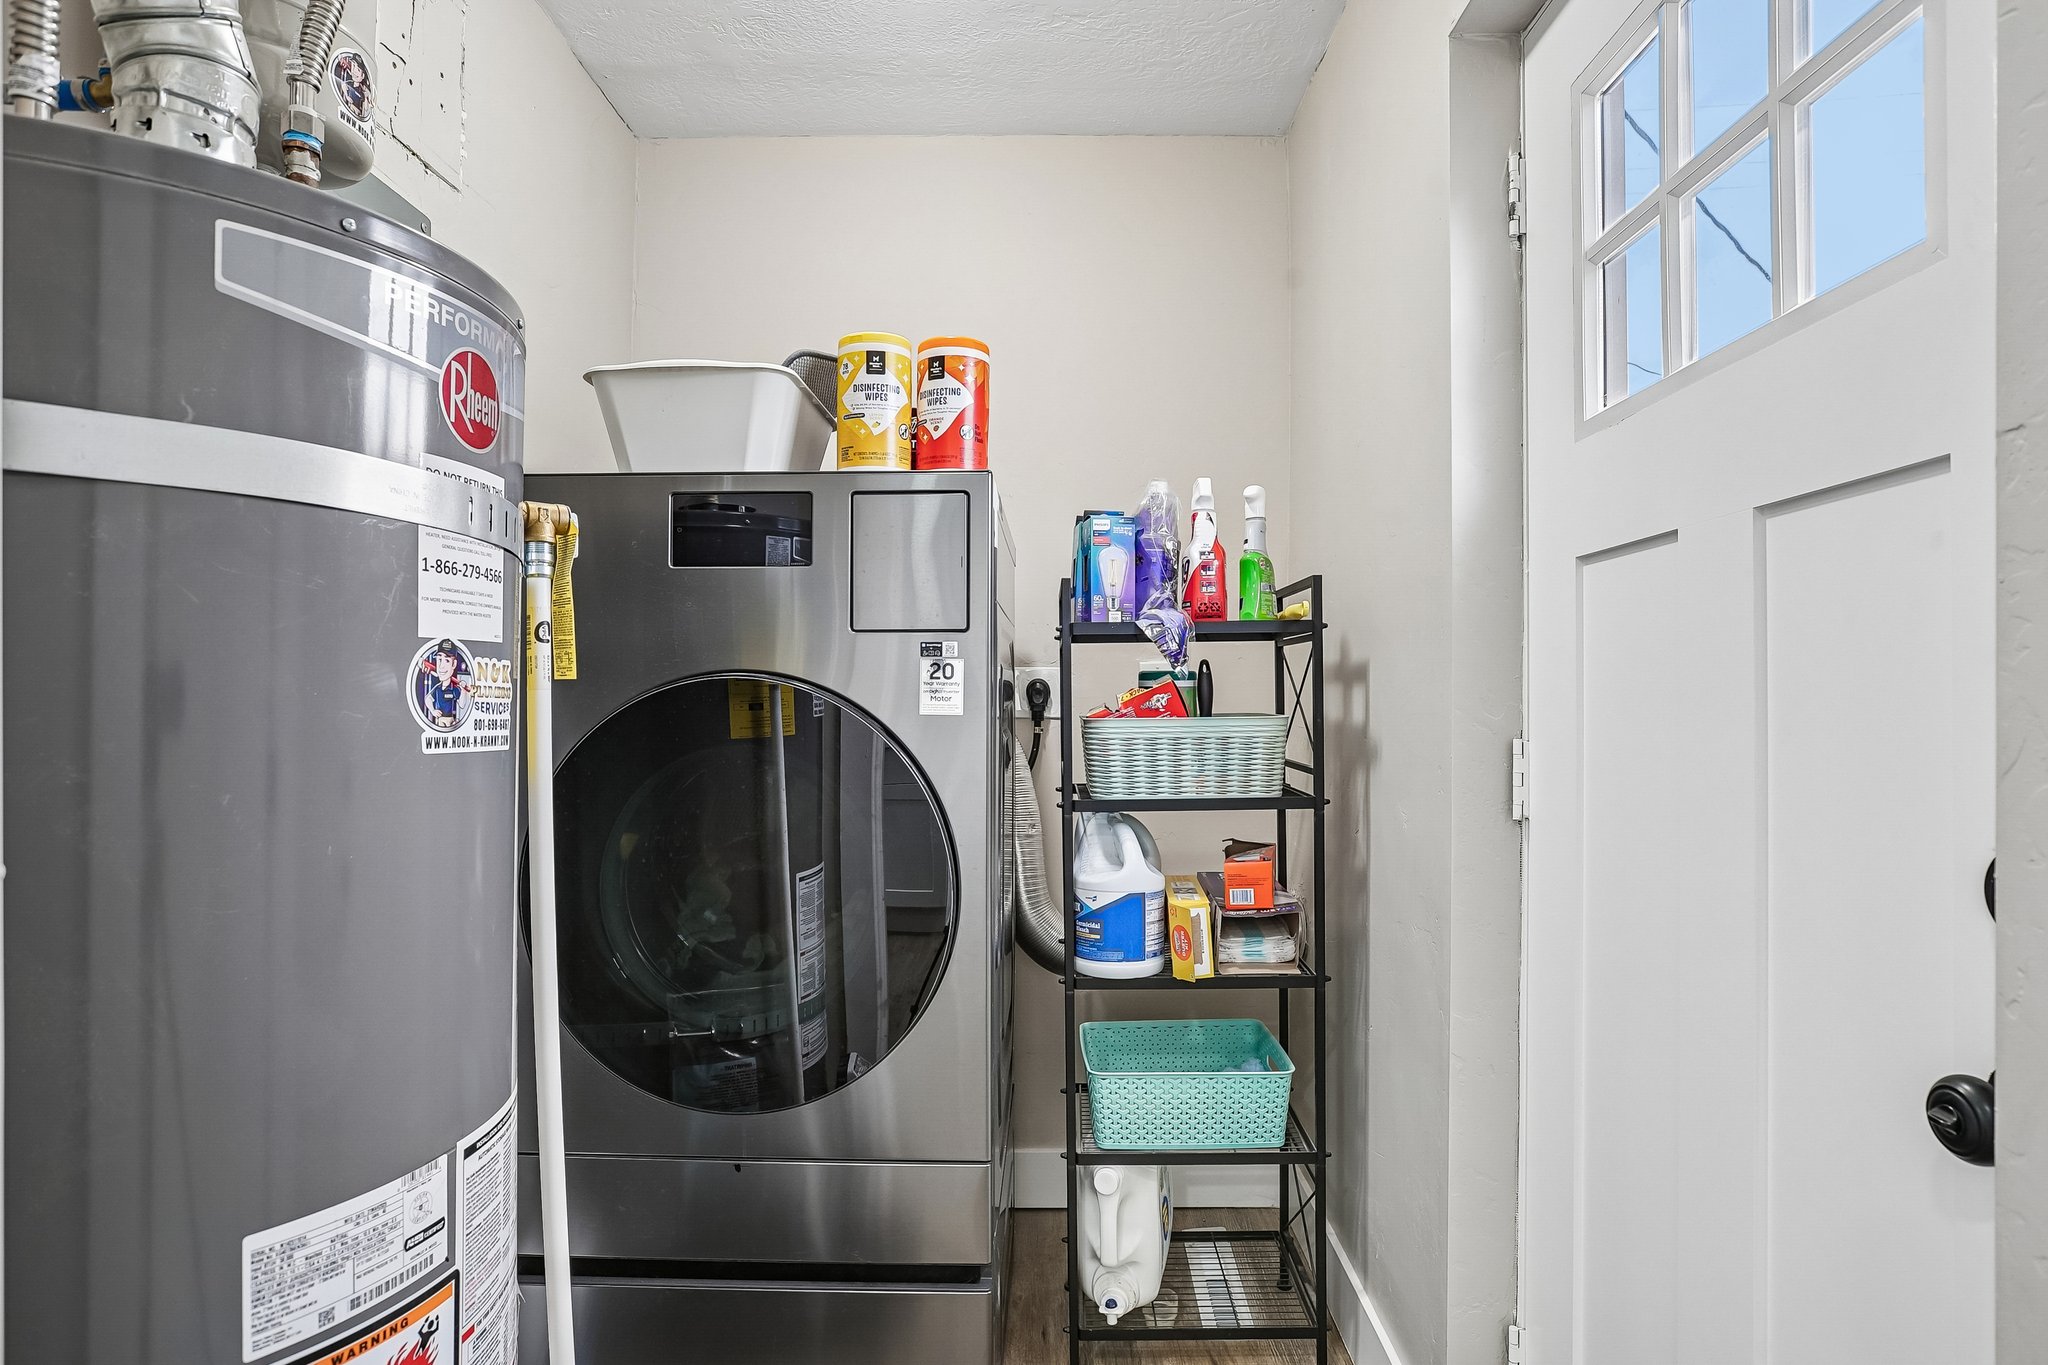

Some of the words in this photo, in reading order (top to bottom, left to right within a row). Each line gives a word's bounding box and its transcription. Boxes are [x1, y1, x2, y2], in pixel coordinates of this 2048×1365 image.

[450, 352, 498, 433] Rheem
[853, 383, 900, 394] DISINFECTING
[919, 387, 961, 400] DISINFECTING
[865, 392, 888, 402] WIPES
[927, 396, 948, 407] WIPES
[422, 557, 502, 584] 1-866-279-4566
[929, 662, 955, 680] 20
[474, 701, 510, 715] SERVICES
[330, 1317, 409, 1365] WARNING
